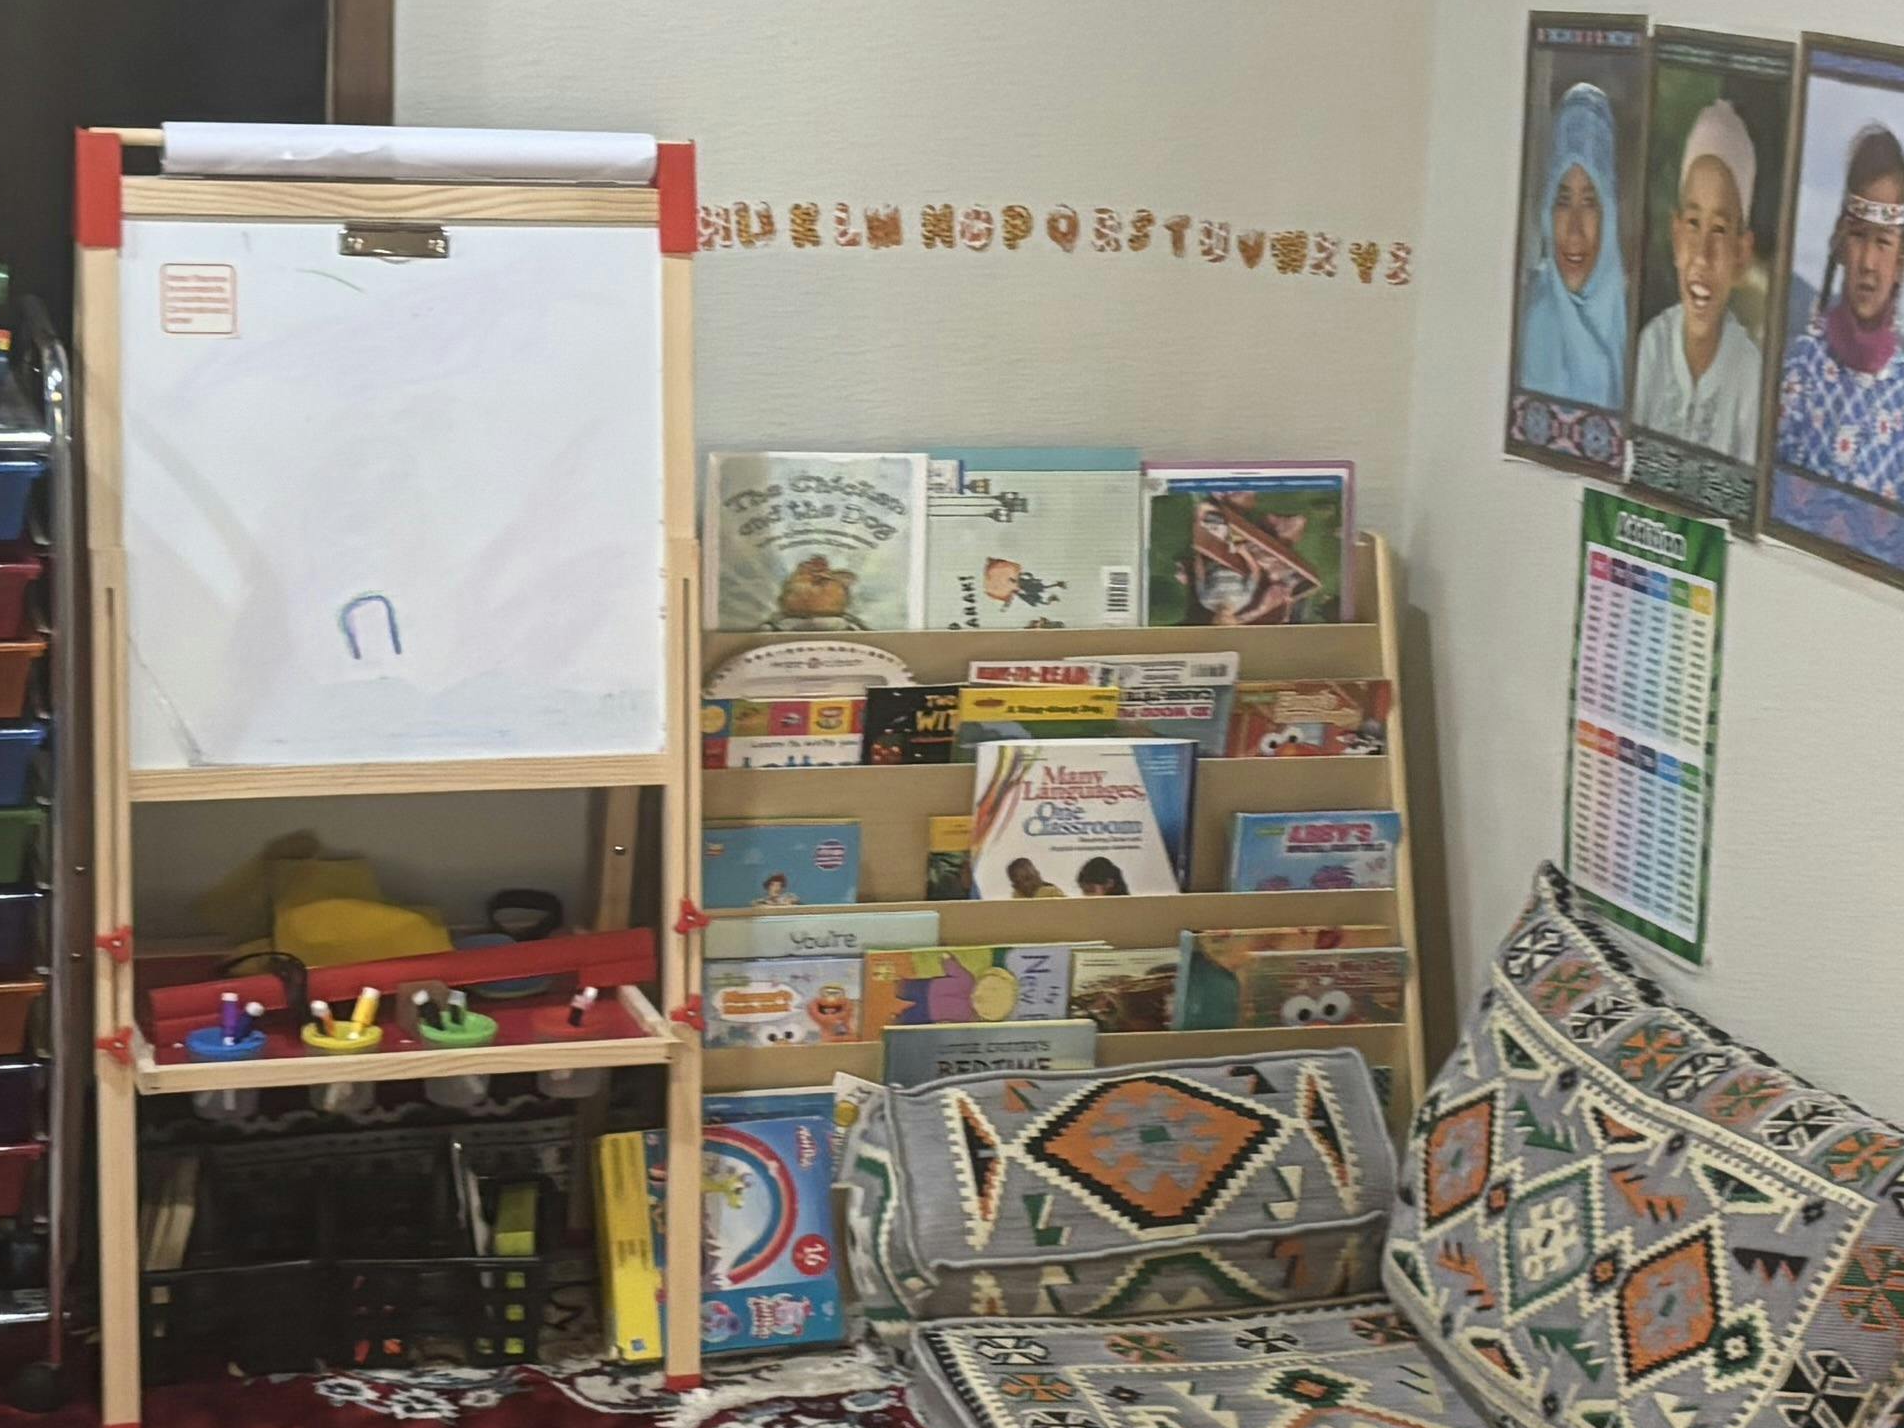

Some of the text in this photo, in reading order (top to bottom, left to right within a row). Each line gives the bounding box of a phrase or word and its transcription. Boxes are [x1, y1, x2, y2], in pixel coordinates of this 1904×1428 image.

[1042, 765, 1110, 786] Many
[1036, 801, 1086, 822] One
[1022, 816, 1143, 837] Classroom
